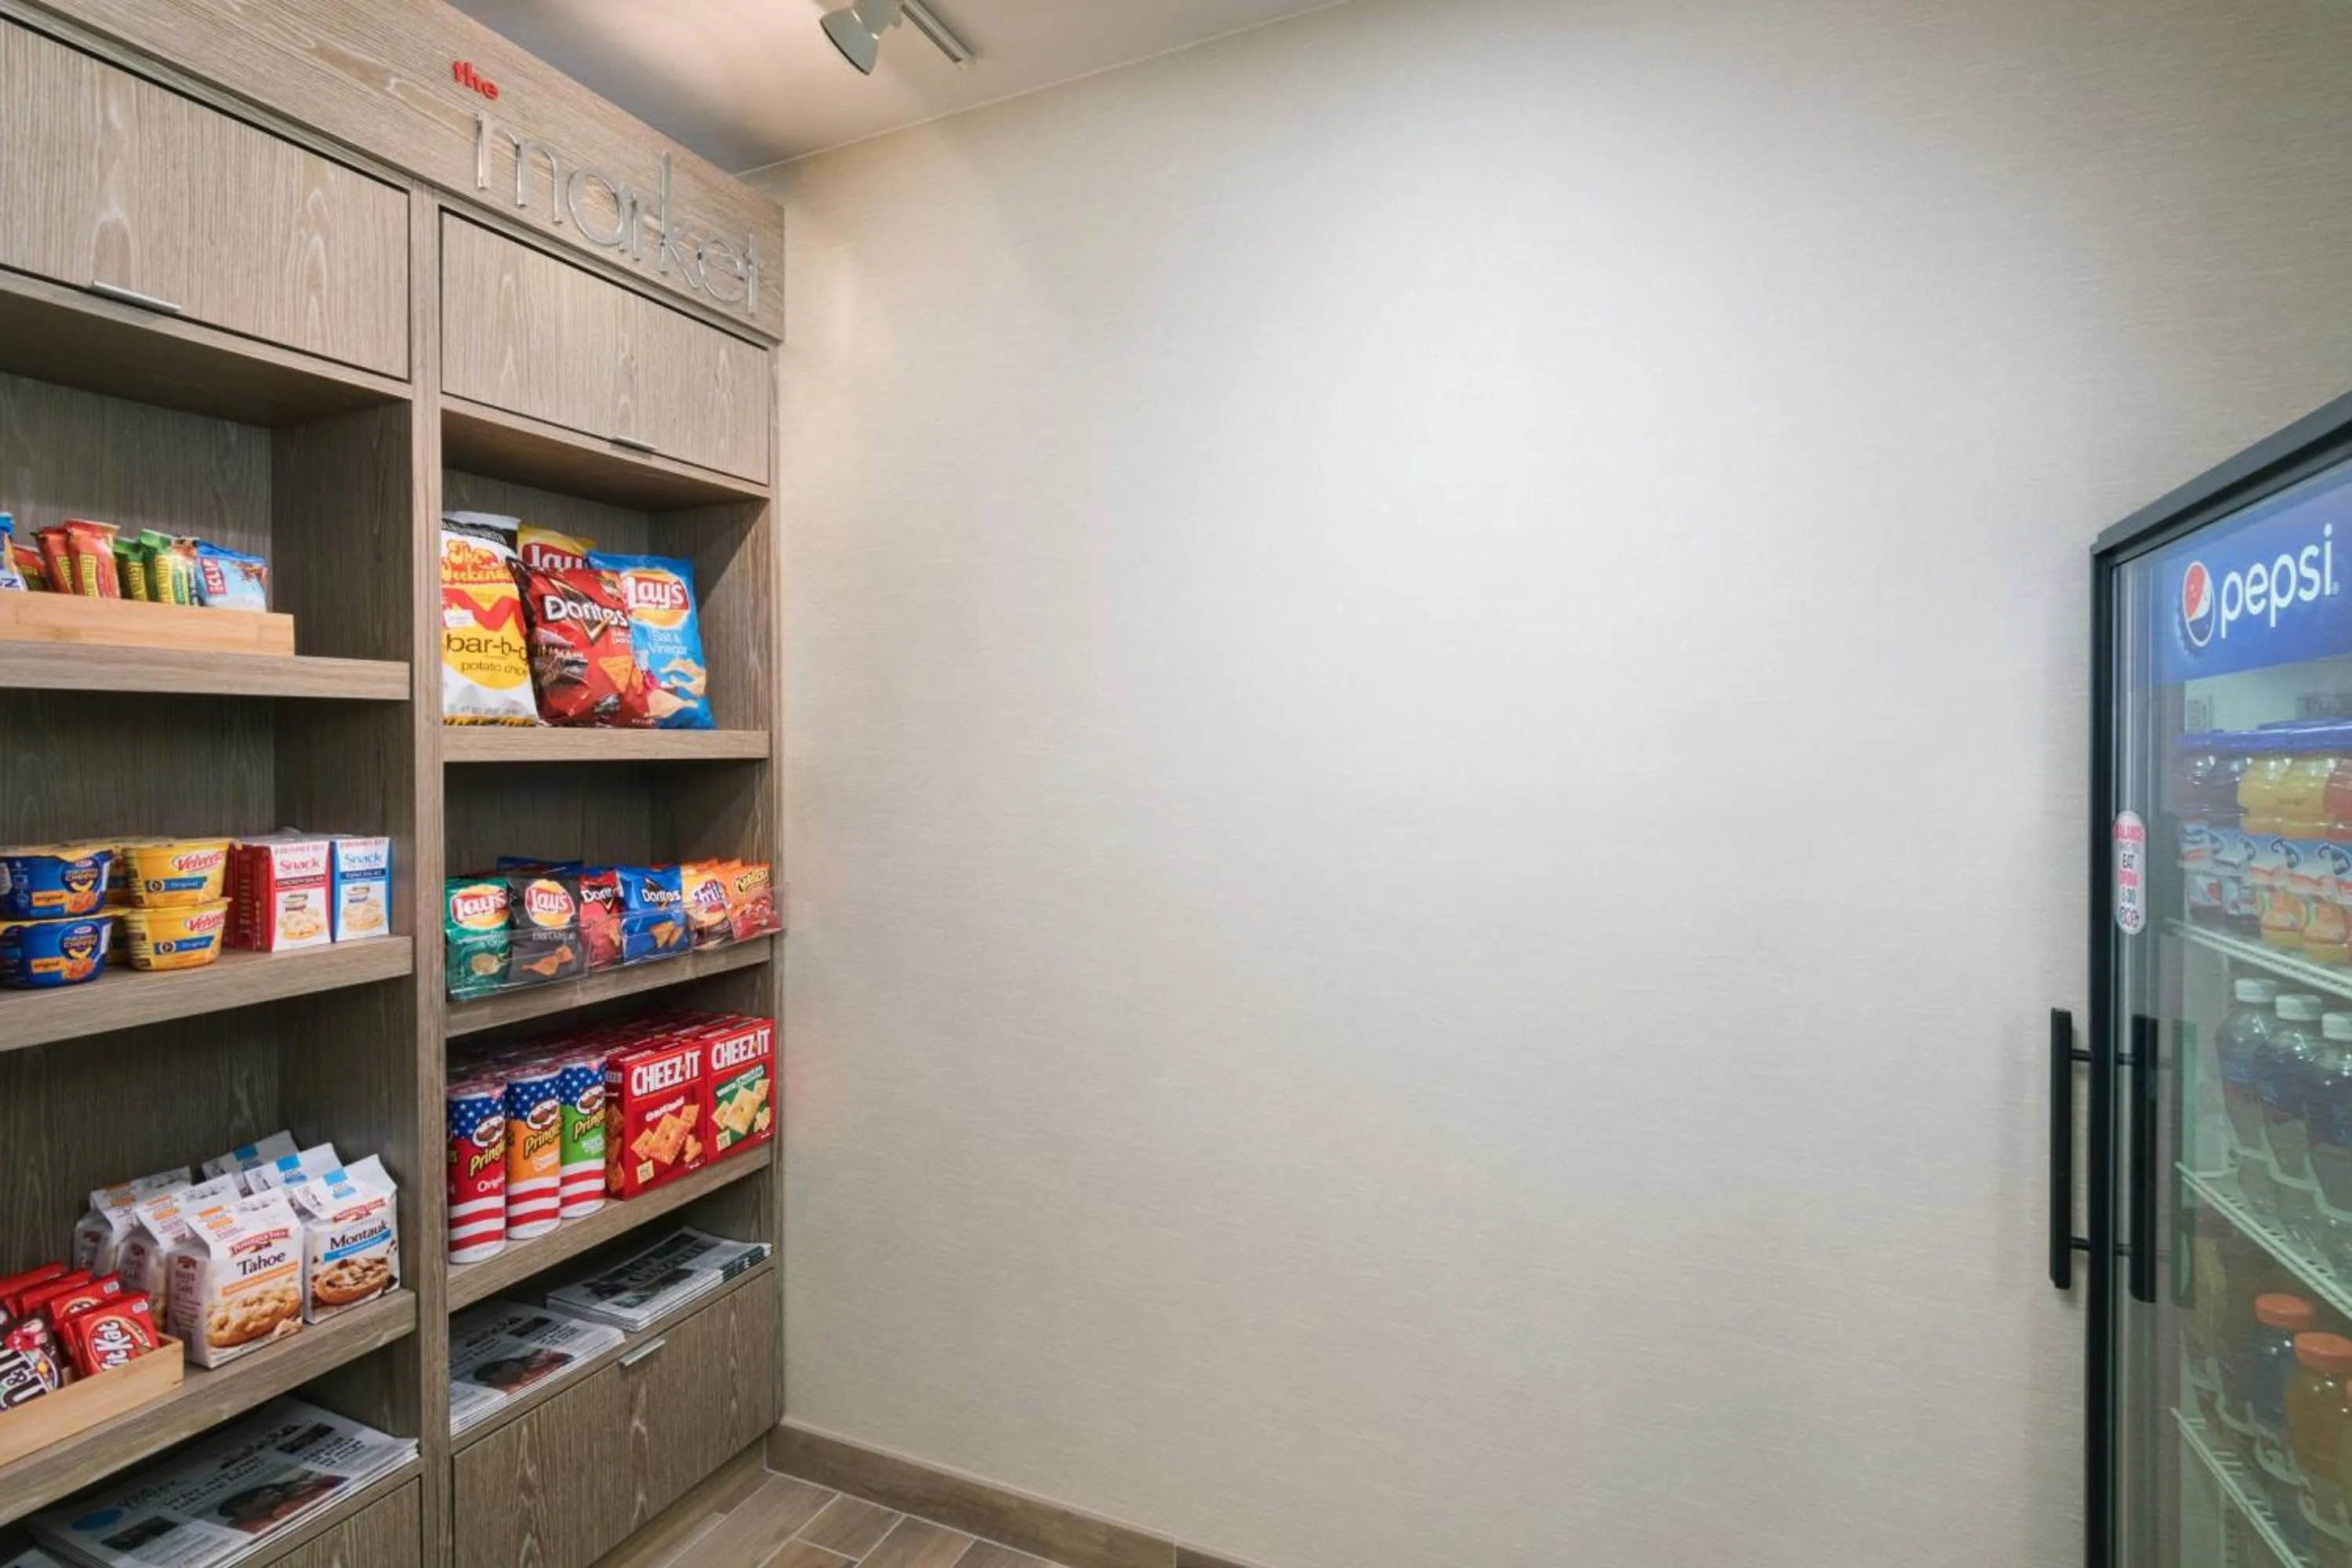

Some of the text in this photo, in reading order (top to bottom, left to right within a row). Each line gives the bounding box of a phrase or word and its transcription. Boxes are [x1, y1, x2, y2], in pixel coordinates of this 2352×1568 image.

[452, 61, 499, 100] the
[476, 111, 757, 319] market
[627, 575, 684, 609] Lay's
[2220, 522, 2333, 639] pepsi
[543, 594, 629, 627] Doritos
[461, 660, 502, 672] potato
[280, 858, 321, 871] Snack
[344, 851, 382, 863] Snack
[531, 889, 568, 913] Lay's
[641, 889, 681, 903] Doritos
[330, 1220, 388, 1250] Montauk
[237, 1252, 286, 1276] Tahoe
